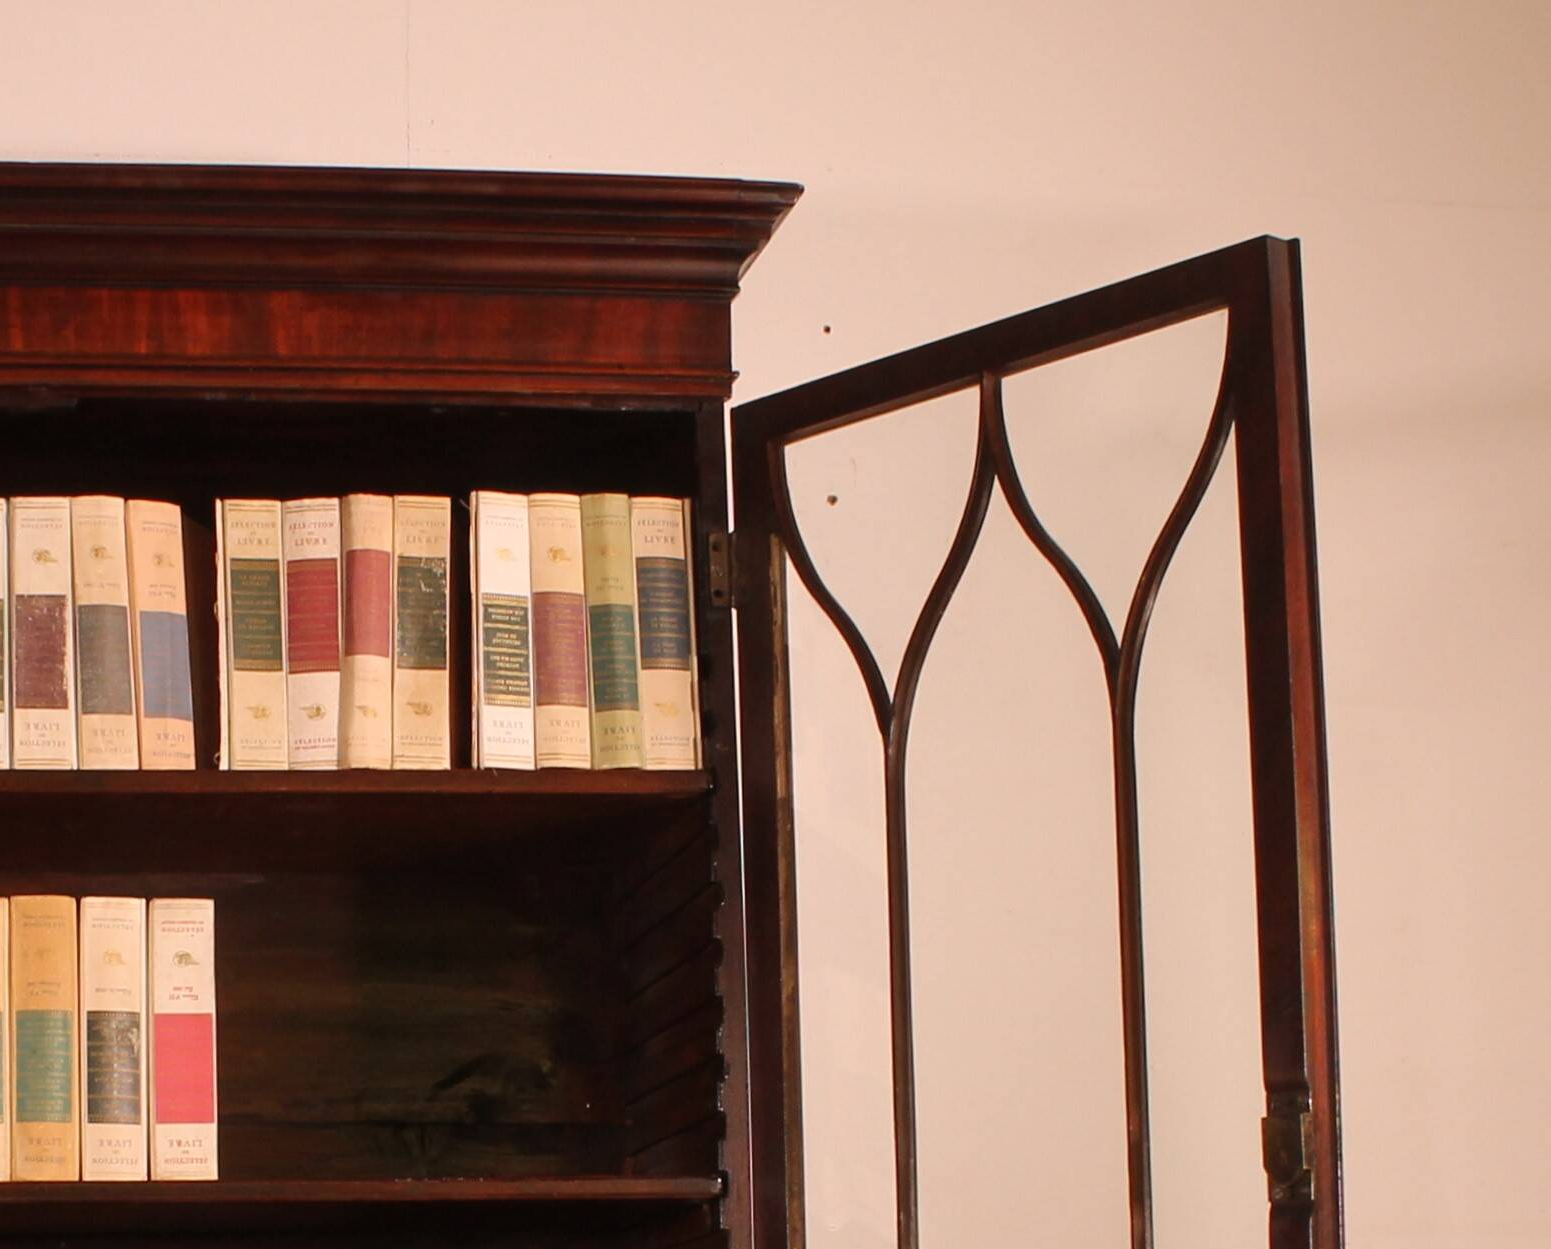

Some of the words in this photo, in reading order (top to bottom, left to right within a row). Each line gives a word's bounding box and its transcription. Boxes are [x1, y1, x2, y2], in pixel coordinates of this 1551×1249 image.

[237, 536, 271, 545] LIVRE
[294, 536, 328, 546] LIVRE
[644, 535, 675, 544] LIVRE
[25, 722, 59, 731] LIVRE
[97, 1138, 133, 1148] LIVRE
[167, 1138, 203, 1148] LIVRE
